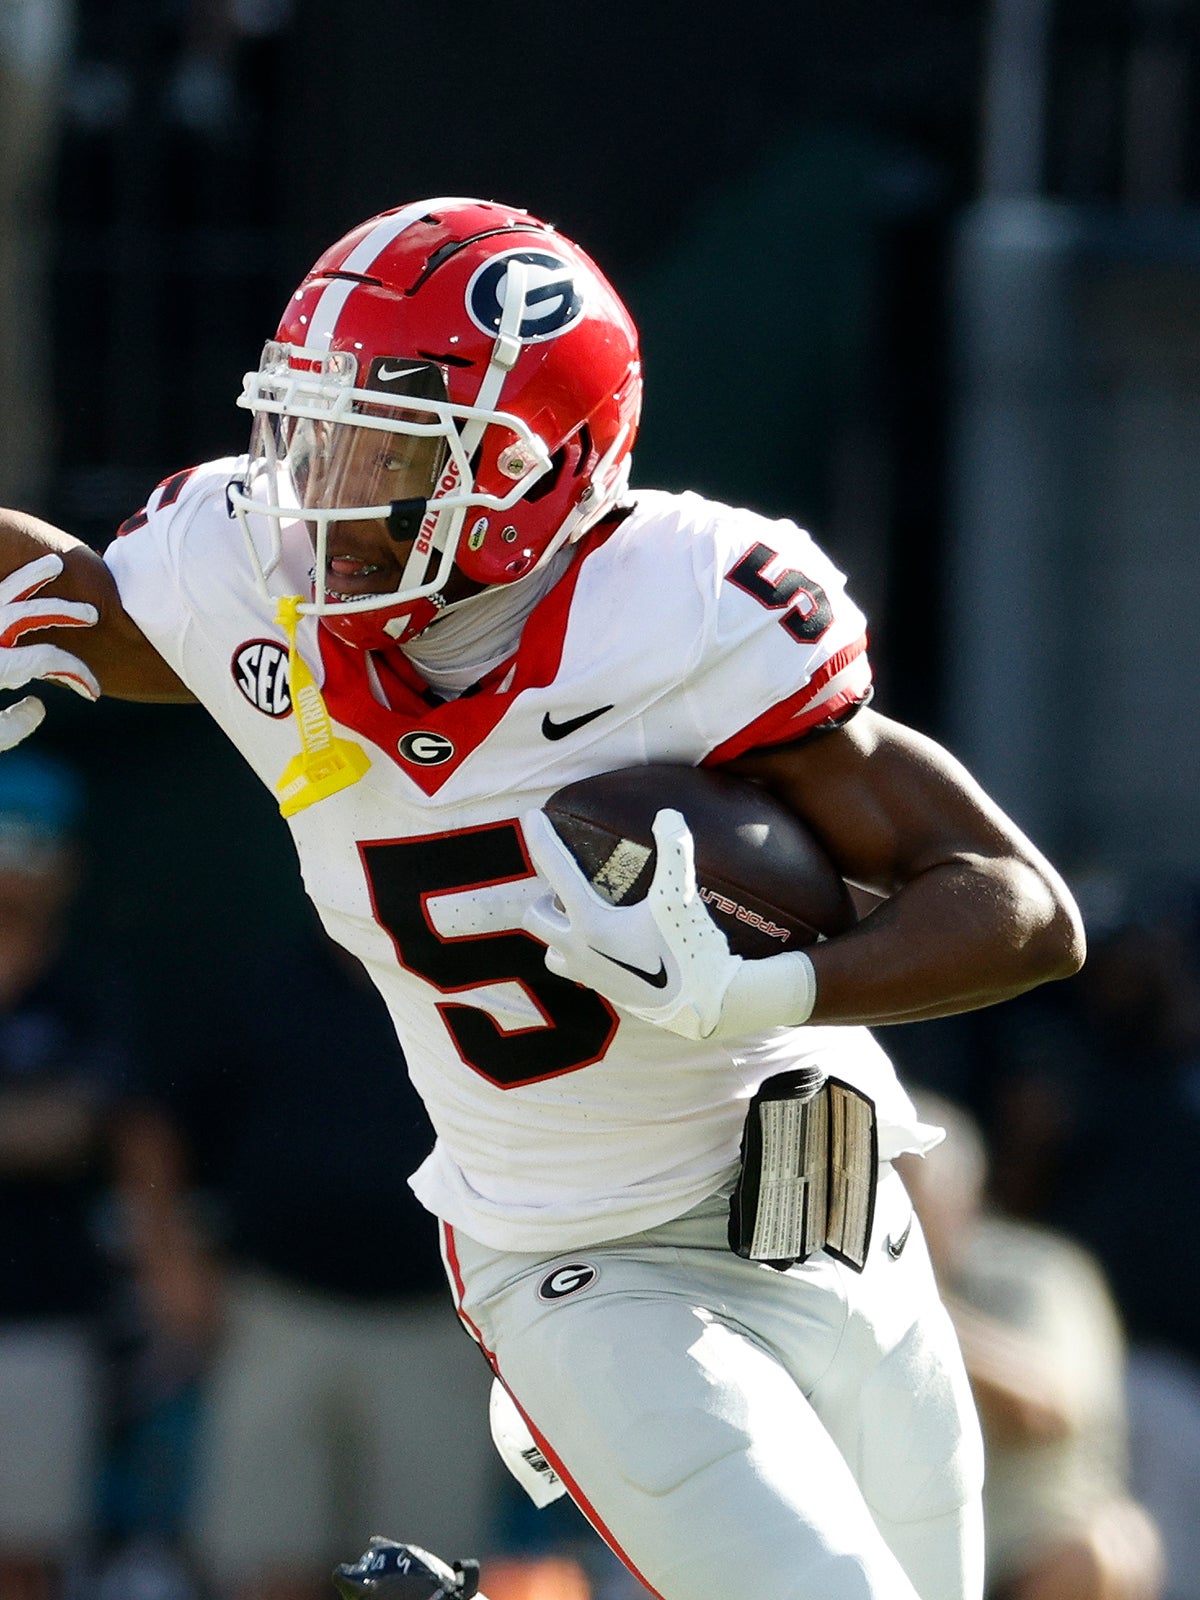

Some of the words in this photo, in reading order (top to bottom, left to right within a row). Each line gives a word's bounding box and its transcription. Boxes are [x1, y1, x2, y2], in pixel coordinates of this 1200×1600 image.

[480, 254, 588, 333] G
[724, 541, 835, 644] 5
[237, 643, 291, 715] SEC
[404, 732, 453, 762] G
[356, 818, 620, 1090] 5
[737, 905, 791, 942] VAPOR
[544, 1264, 596, 1298] G
